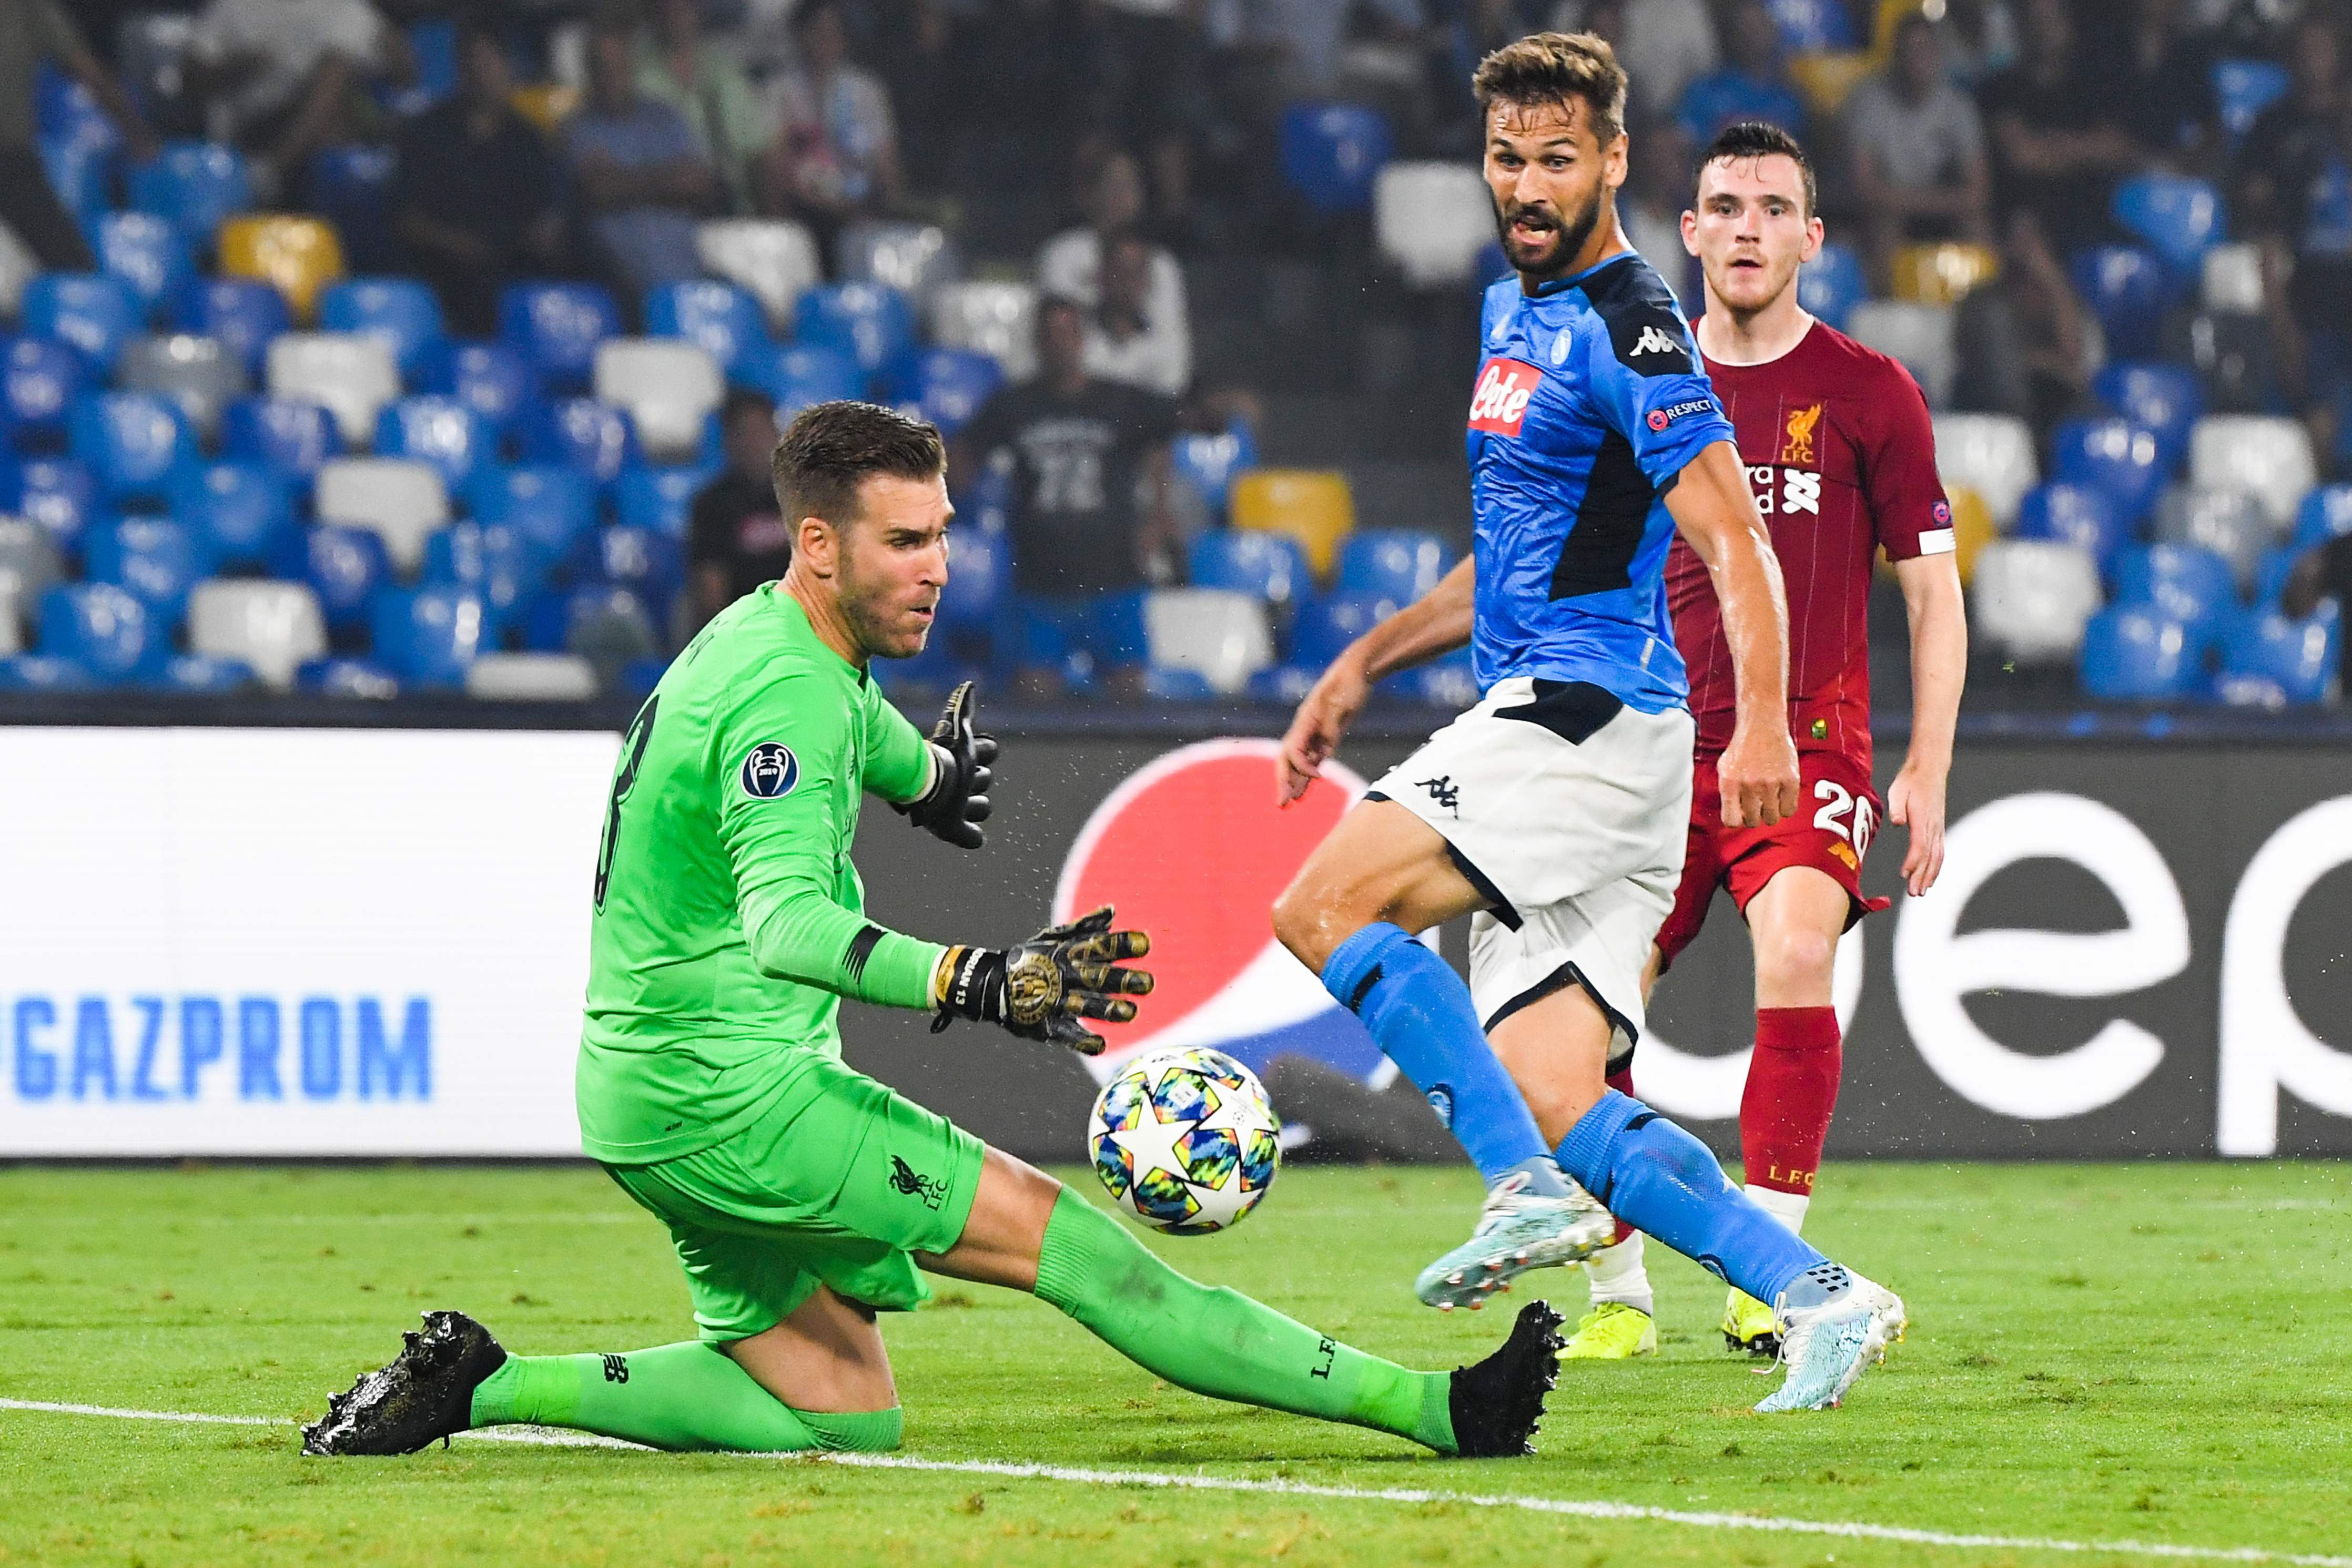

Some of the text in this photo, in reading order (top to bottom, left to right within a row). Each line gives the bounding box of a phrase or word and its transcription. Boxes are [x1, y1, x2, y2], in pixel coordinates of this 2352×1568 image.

[1666, 400, 1711, 420] RESPECT
[1781, 450, 1813, 463] LFC
[1813, 779, 1873, 863] 26
[955, 990, 966, 1005] 13
[14, 996, 431, 1101] GAZPROM
[927, 1179, 948, 1211] LFC
